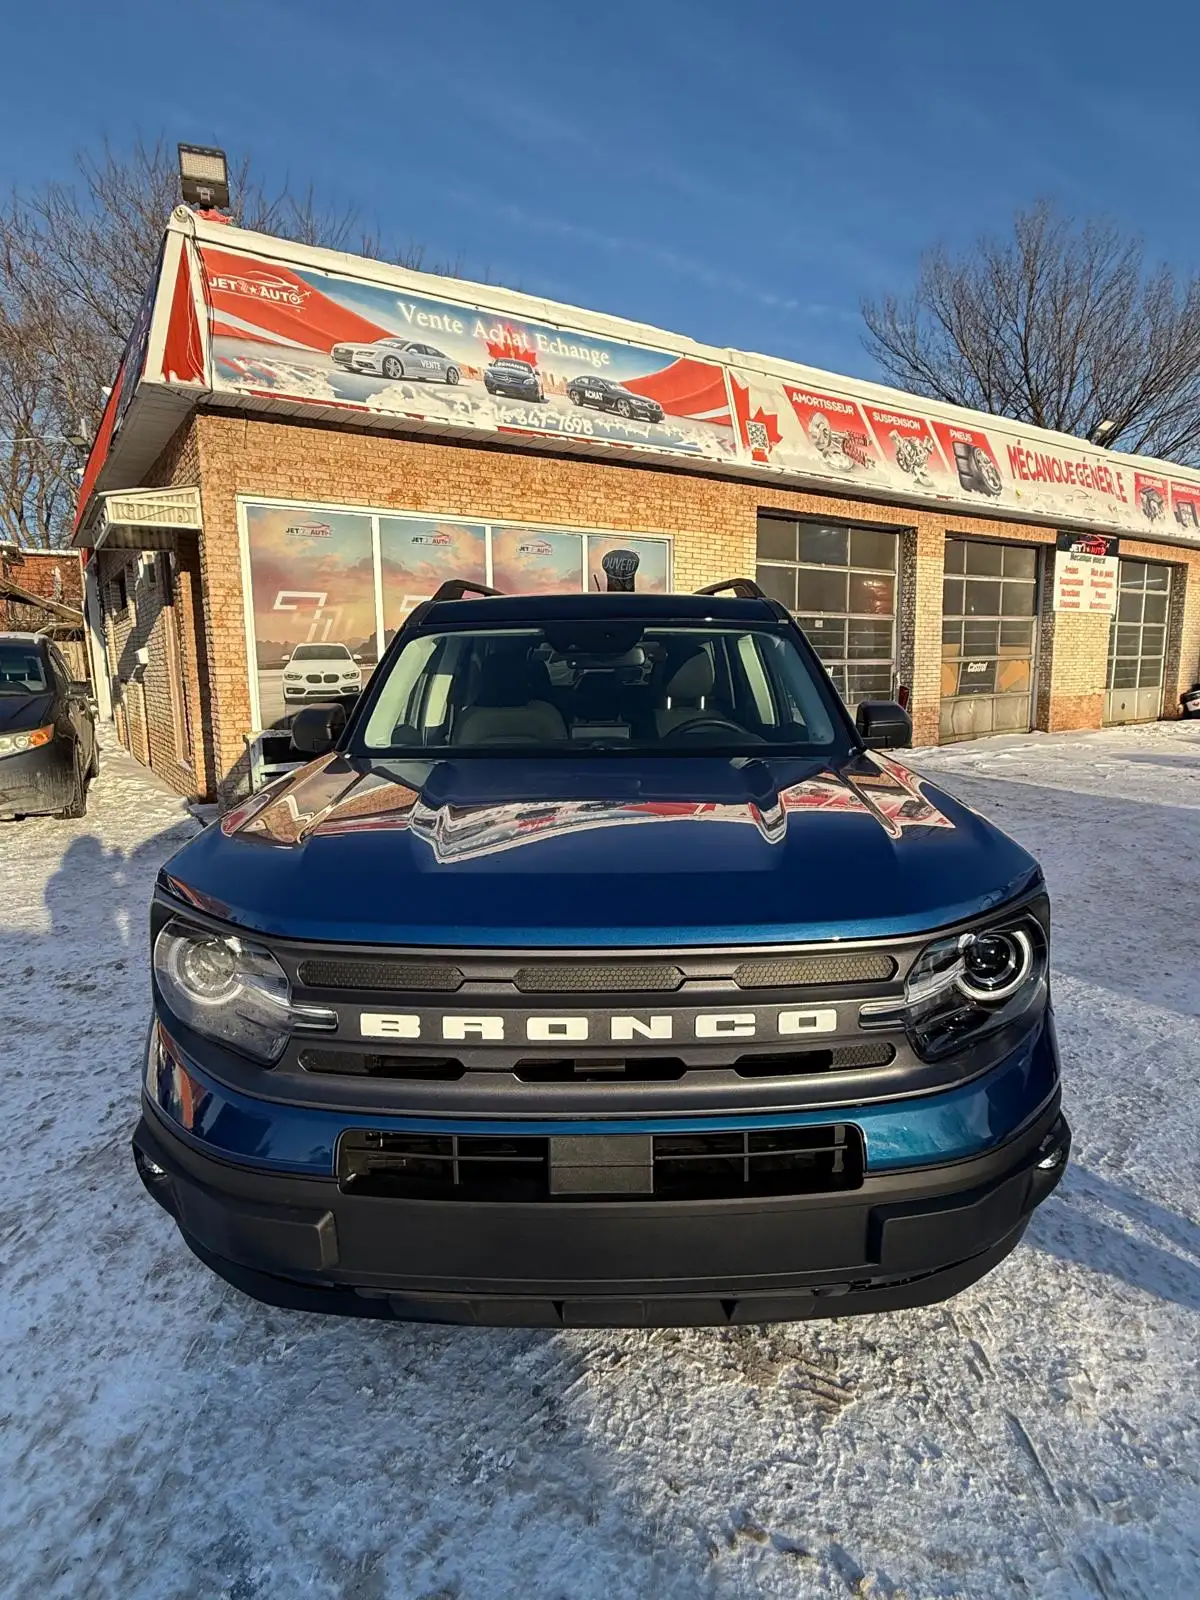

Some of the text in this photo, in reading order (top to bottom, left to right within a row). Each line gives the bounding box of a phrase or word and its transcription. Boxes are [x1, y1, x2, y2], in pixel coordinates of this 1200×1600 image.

[209, 277, 237, 290] JET
[260, 285, 300, 304] AUTO
[398, 301, 610, 367] Vente Achat Echange
[421, 360, 441, 370] VENTE
[792, 391, 855, 416] AMORTISSEUR
[872, 411, 920, 430] SUSPENSION
[950, 428, 972, 442] PNEUS
[1007, 439, 1128, 503] MÉCANIQUE GÉNÉRLE
[603, 556, 637, 571] OUVERT
[360, 1009, 837, 1041] BRONCO
